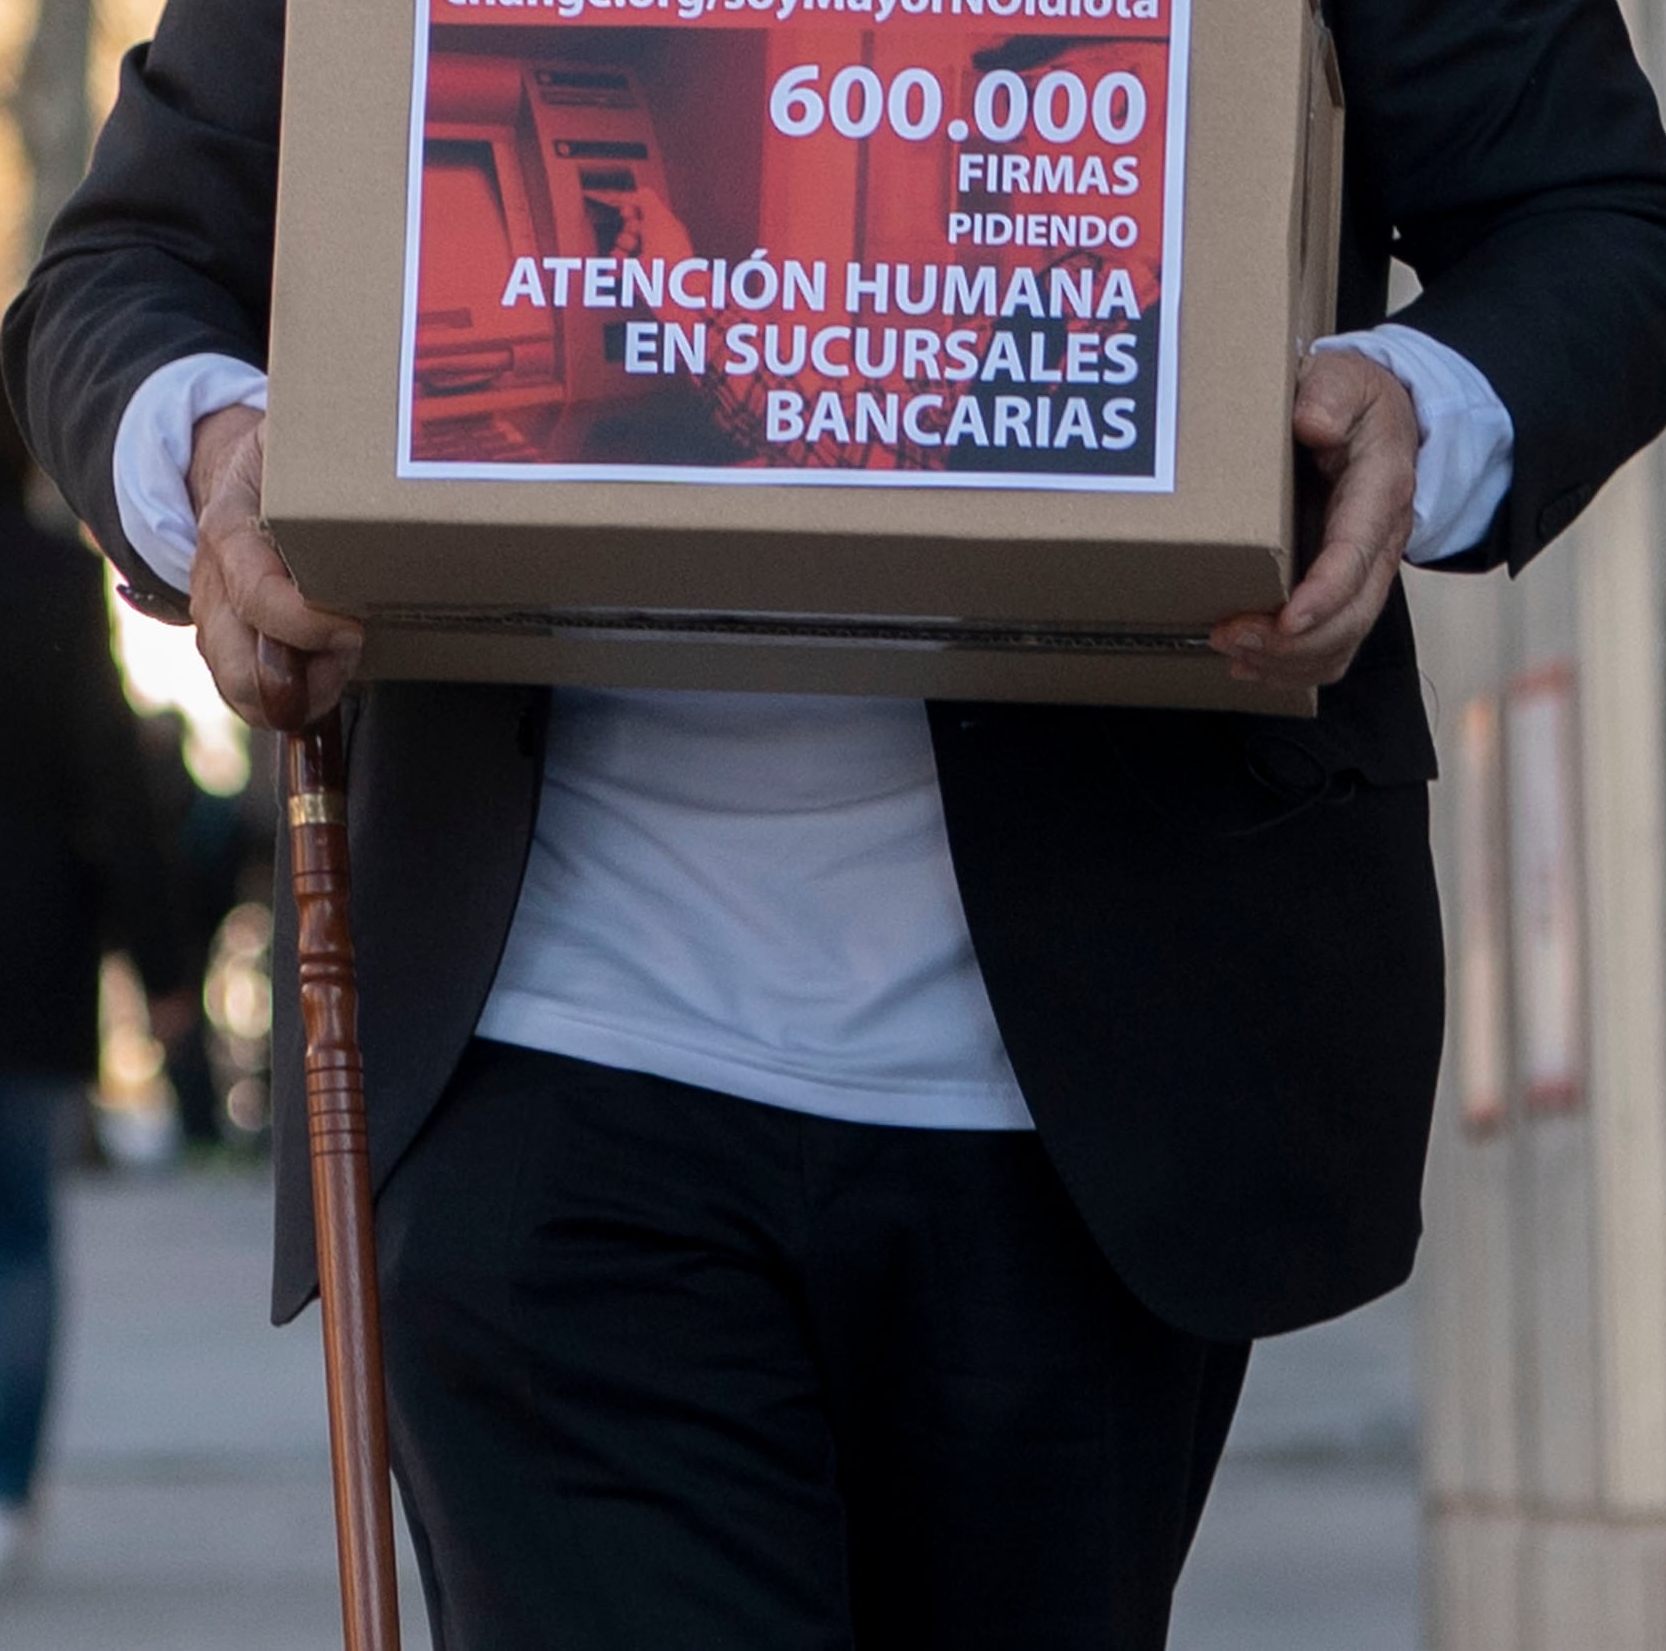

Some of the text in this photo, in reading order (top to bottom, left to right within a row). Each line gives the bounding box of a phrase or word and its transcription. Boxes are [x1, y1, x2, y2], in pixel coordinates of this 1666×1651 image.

[769, 64, 1147, 144] 600.000
[958, 153, 1139, 195] FIRMAS
[947, 212, 1138, 248] PIDIENDO
[501, 249, 1141, 319] ATENCIÓN HUMANA
[625, 321, 1139, 385] EN SUCURSALES
[766, 390, 1138, 449] BANCARIAS
